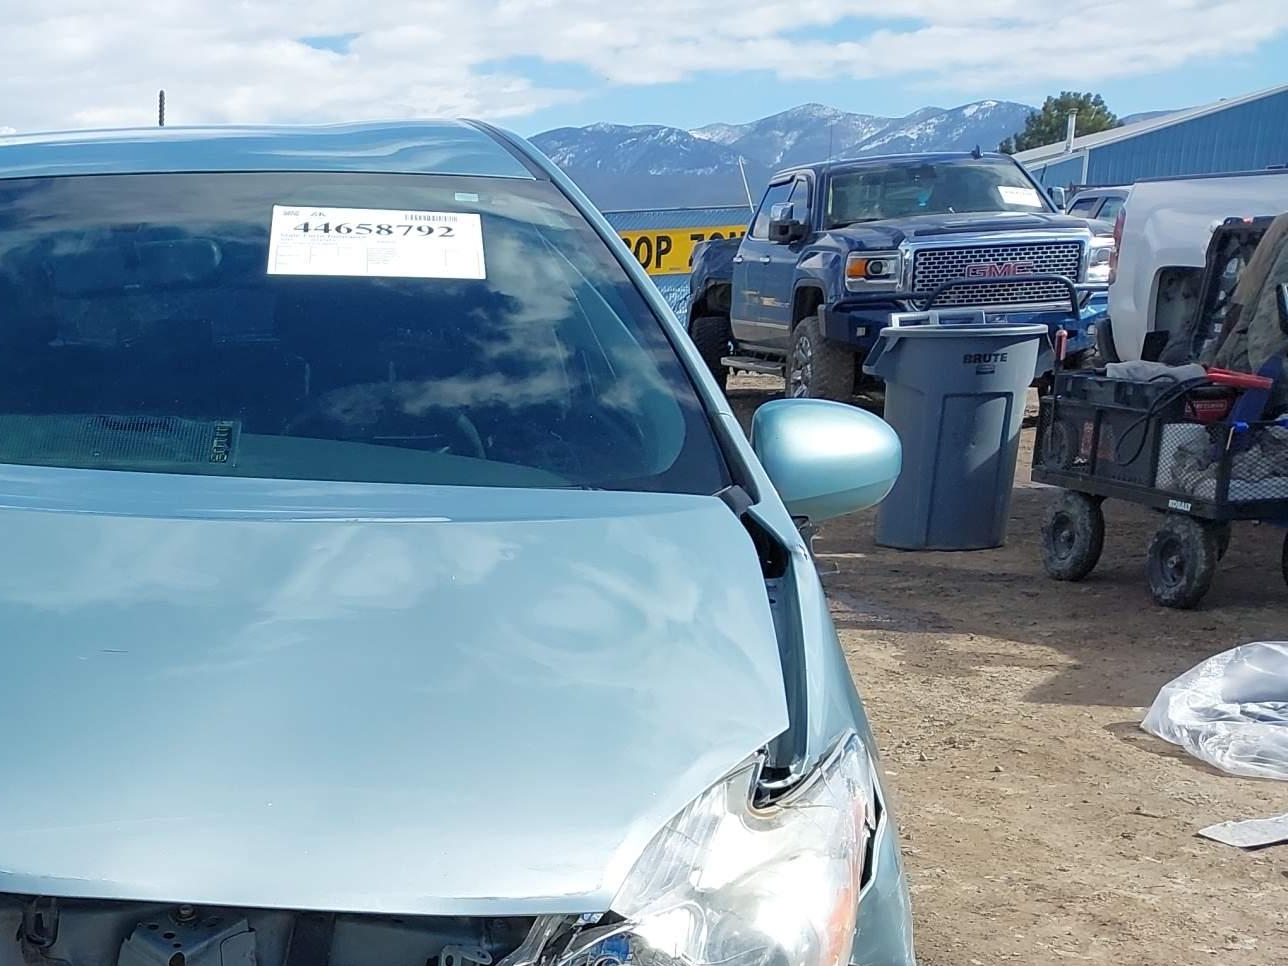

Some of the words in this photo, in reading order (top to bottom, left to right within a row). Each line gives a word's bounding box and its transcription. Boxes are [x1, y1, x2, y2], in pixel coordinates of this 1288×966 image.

[293, 222, 455, 237] 44658792
[966, 261, 1033, 277] GMC
[963, 353, 1008, 364] BRUTE
